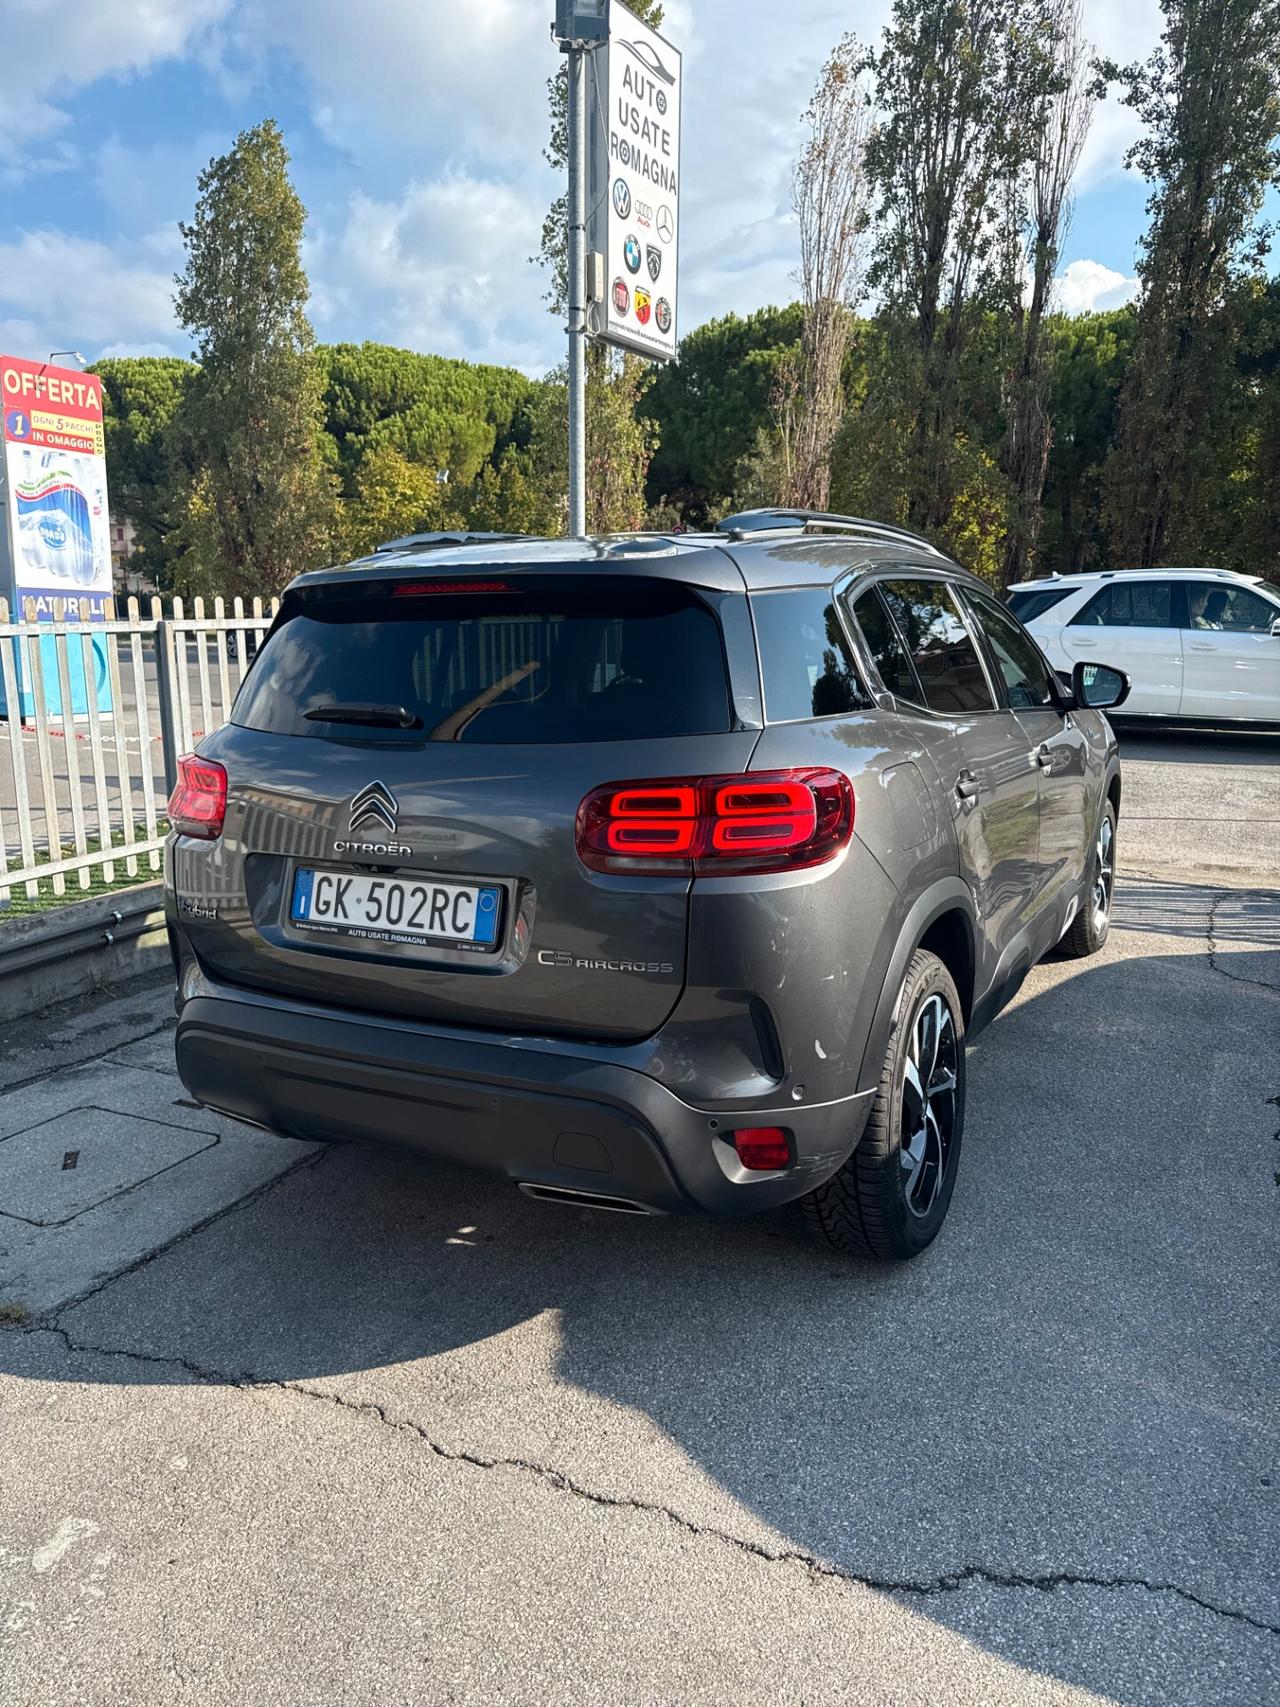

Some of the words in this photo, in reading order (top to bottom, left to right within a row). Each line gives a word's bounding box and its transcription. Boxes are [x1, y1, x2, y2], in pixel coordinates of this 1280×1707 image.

[618, 97, 671, 157] USATE
[610, 131, 677, 197] ROMAGNA
[4, 368, 100, 411] OFFERTA
[14, 415, 24, 435] 1
[33, 415, 54, 426] OGNI
[56, 418, 64, 431] 5
[65, 423, 93, 434] PACCHI
[32, 431, 44, 442] IN
[47, 434, 94, 449] OMAGGIO
[95, 424, 103, 455] PROMO
[333, 841, 412, 858] CITROËN
[314, 875, 353, 919] GK
[365, 881, 473, 933] 502RC
[348, 929, 367, 938] AUTO
[368, 932, 389, 941] USATE
[391, 935, 427, 946] ROMAGNA
[537, 949, 573, 967] C5
[576, 959, 674, 973] AIRCROSS
